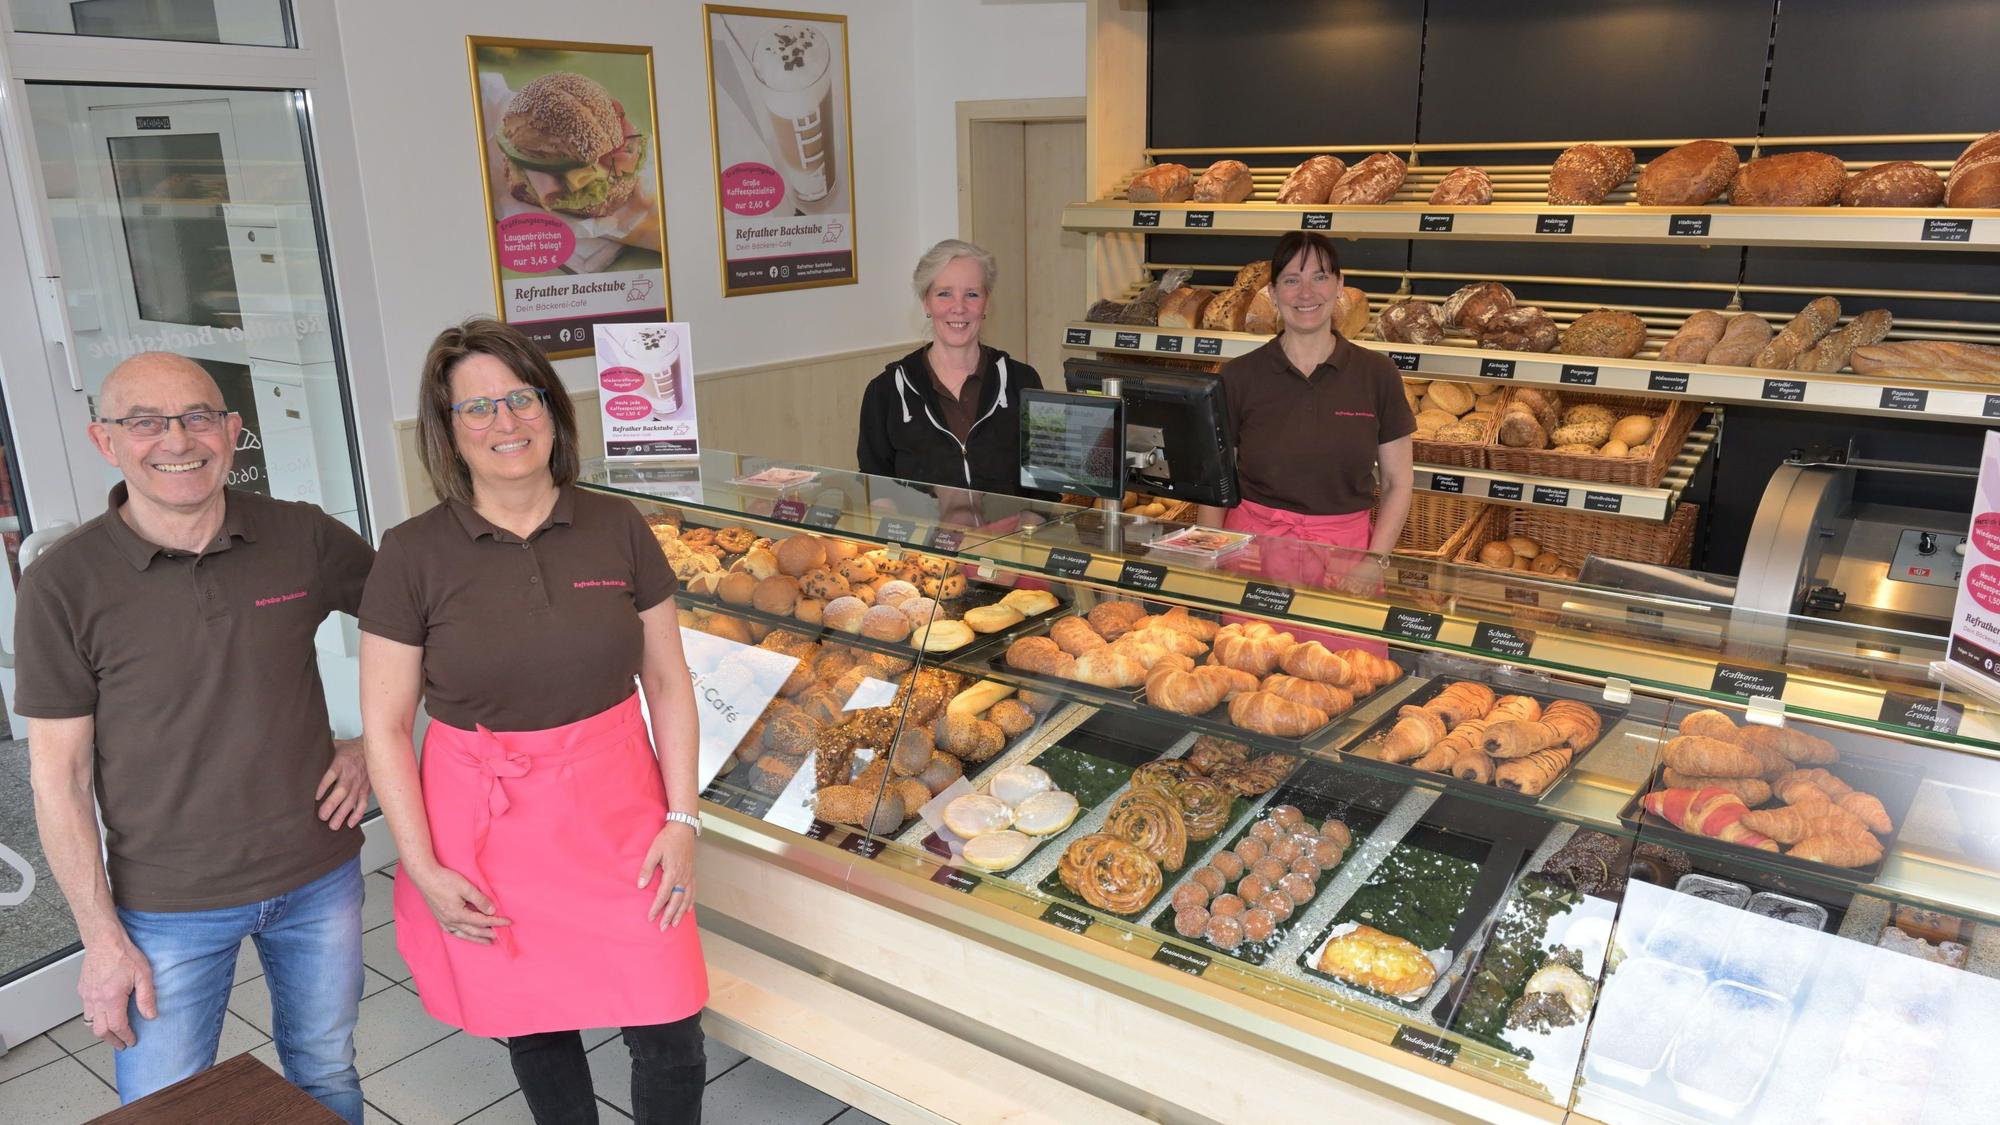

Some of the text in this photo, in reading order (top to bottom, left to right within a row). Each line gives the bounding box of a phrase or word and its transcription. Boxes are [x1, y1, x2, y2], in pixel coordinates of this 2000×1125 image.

[504, 231, 562, 243] Laugenbrötchen
[735, 224, 823, 240] Refrather Backstube
[504, 240, 562, 252] herzhaft belegt
[513, 255, 558, 266] nur 3,45 €
[515, 280, 626, 301] Refrather Backstube
[515, 299, 588, 313] Dein Bäckerei-Café
[612, 424, 673, 434] Refrather Backstube
[1398, 614, 1424, 624] Nougat-
[1965, 613, 2000, 635] Refrather
[1401, 621, 1432, 632] Croissant
[1488, 629, 1516, 639] Schoko-
[1491, 637, 1525, 648] Croissant
[1719, 669, 1764, 683] Kraftkorn-
[1734, 680, 1774, 693] Croissant
[1911, 703, 1938, 713] Mini-
[1904, 710, 1950, 724] Croissant
